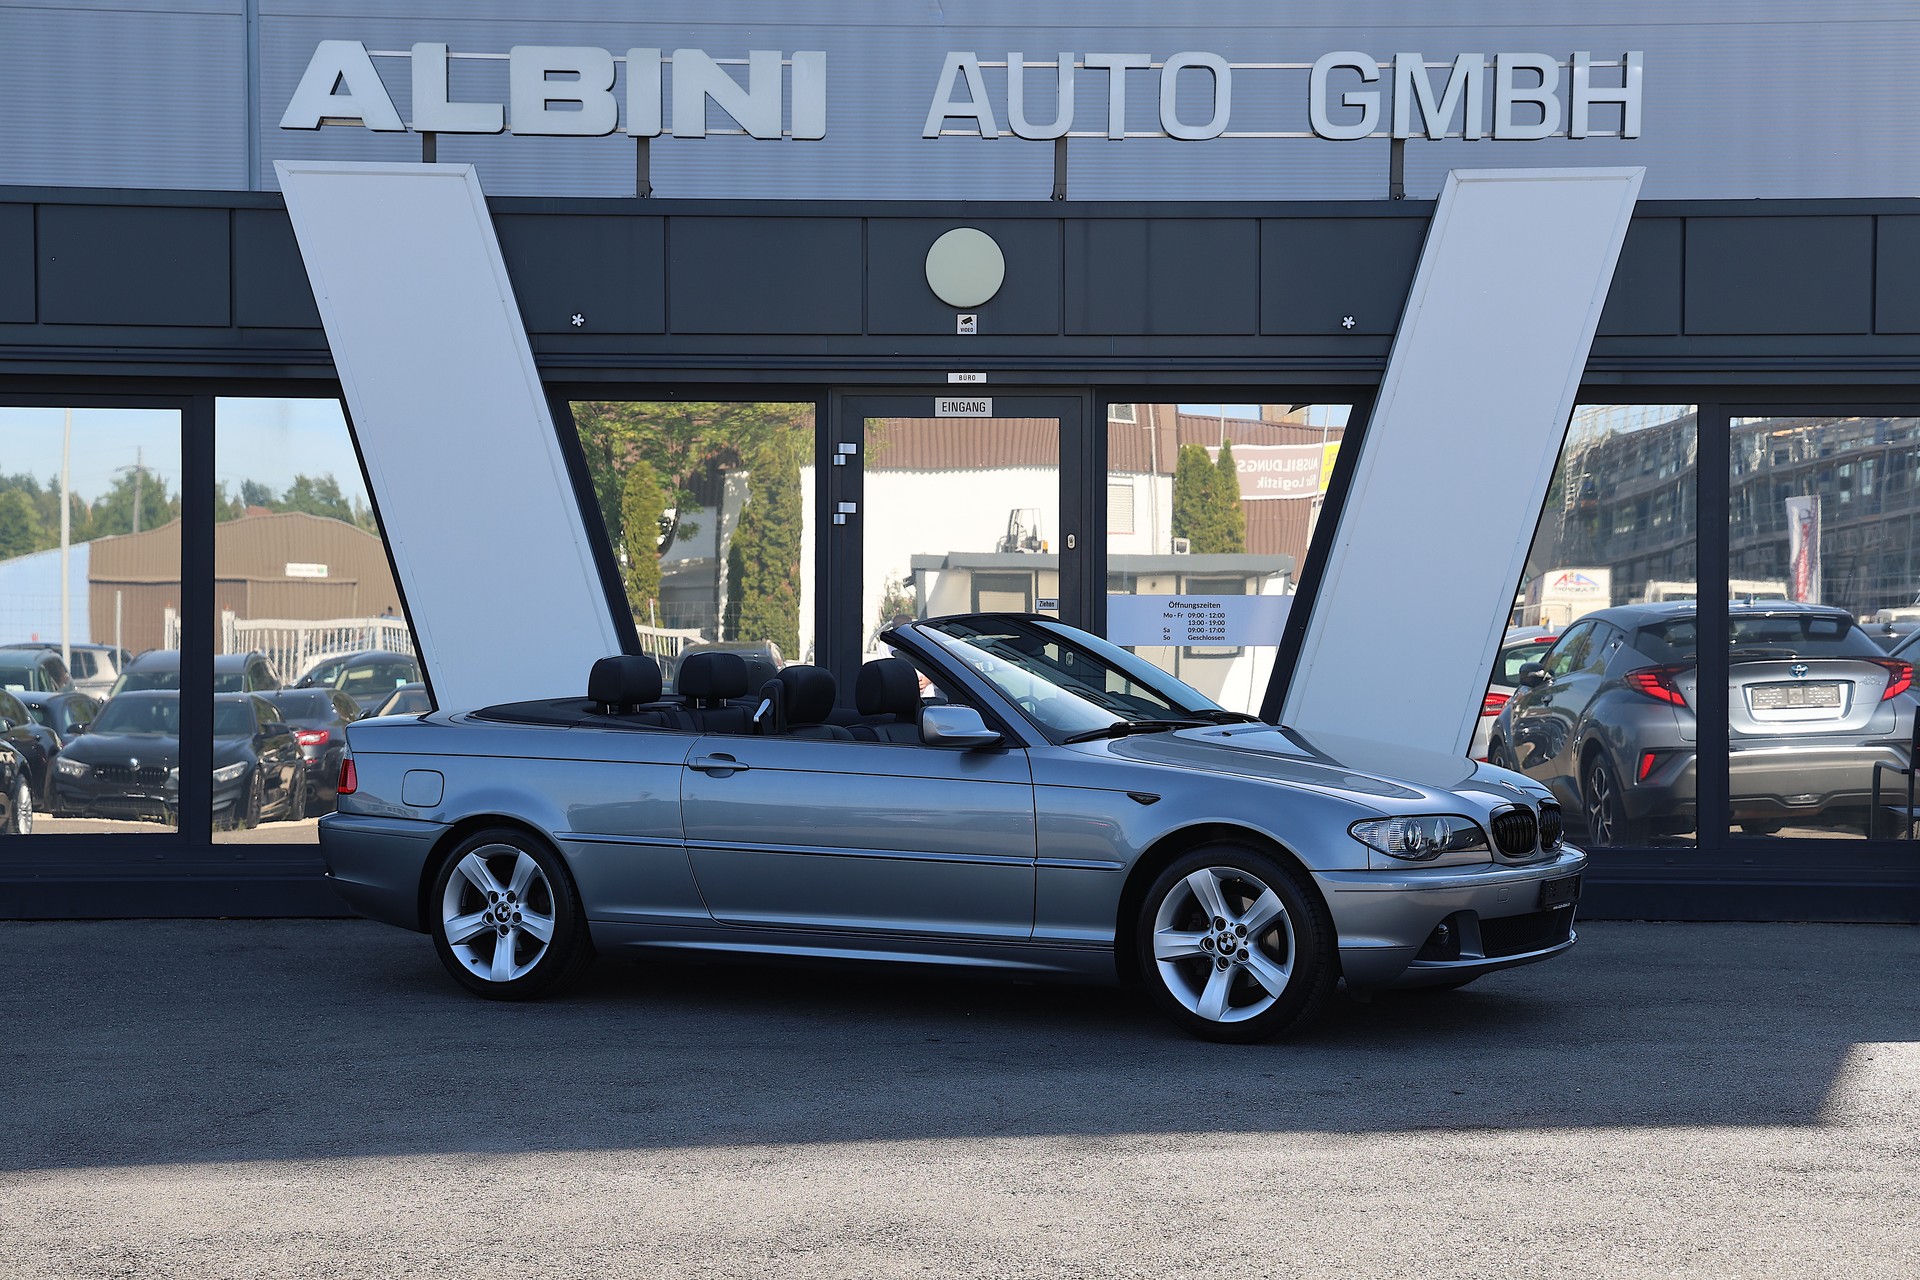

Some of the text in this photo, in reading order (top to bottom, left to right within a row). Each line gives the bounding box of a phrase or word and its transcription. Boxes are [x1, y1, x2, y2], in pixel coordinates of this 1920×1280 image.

[279, 39, 1644, 141] ALBINI AUTO GMBH
[942, 401, 986, 413] EINGANG
[1039, 600, 1055, 608] Ziehen
[1168, 601, 1221, 610] Öffnungszeiten
